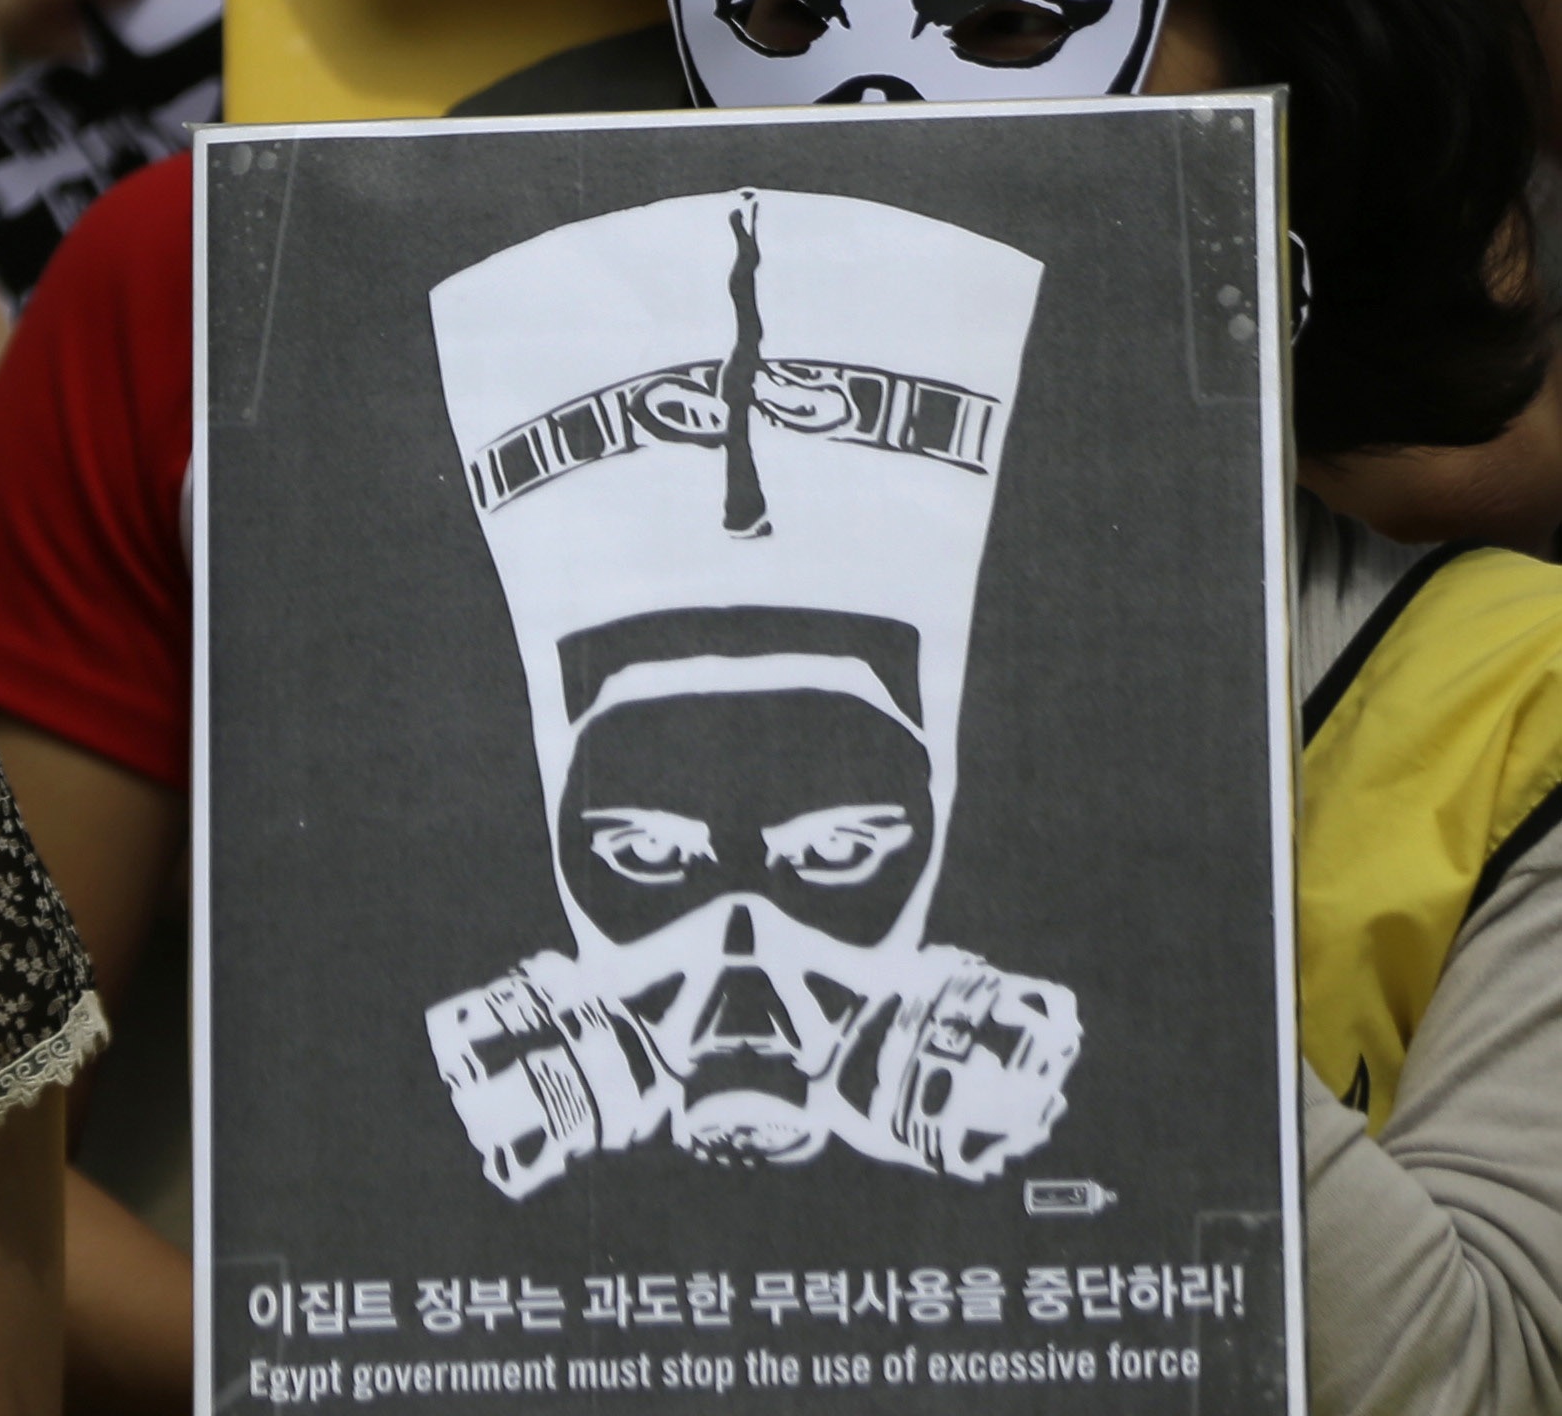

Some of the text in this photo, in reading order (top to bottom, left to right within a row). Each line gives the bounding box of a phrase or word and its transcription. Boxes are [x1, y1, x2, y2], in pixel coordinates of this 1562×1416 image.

[248, 1264, 1245, 1337] 이집트 정부는 과도한 무력사용을 중단하라!
[249, 1340, 1201, 1404] Egypt government must stop the use of excessive force
